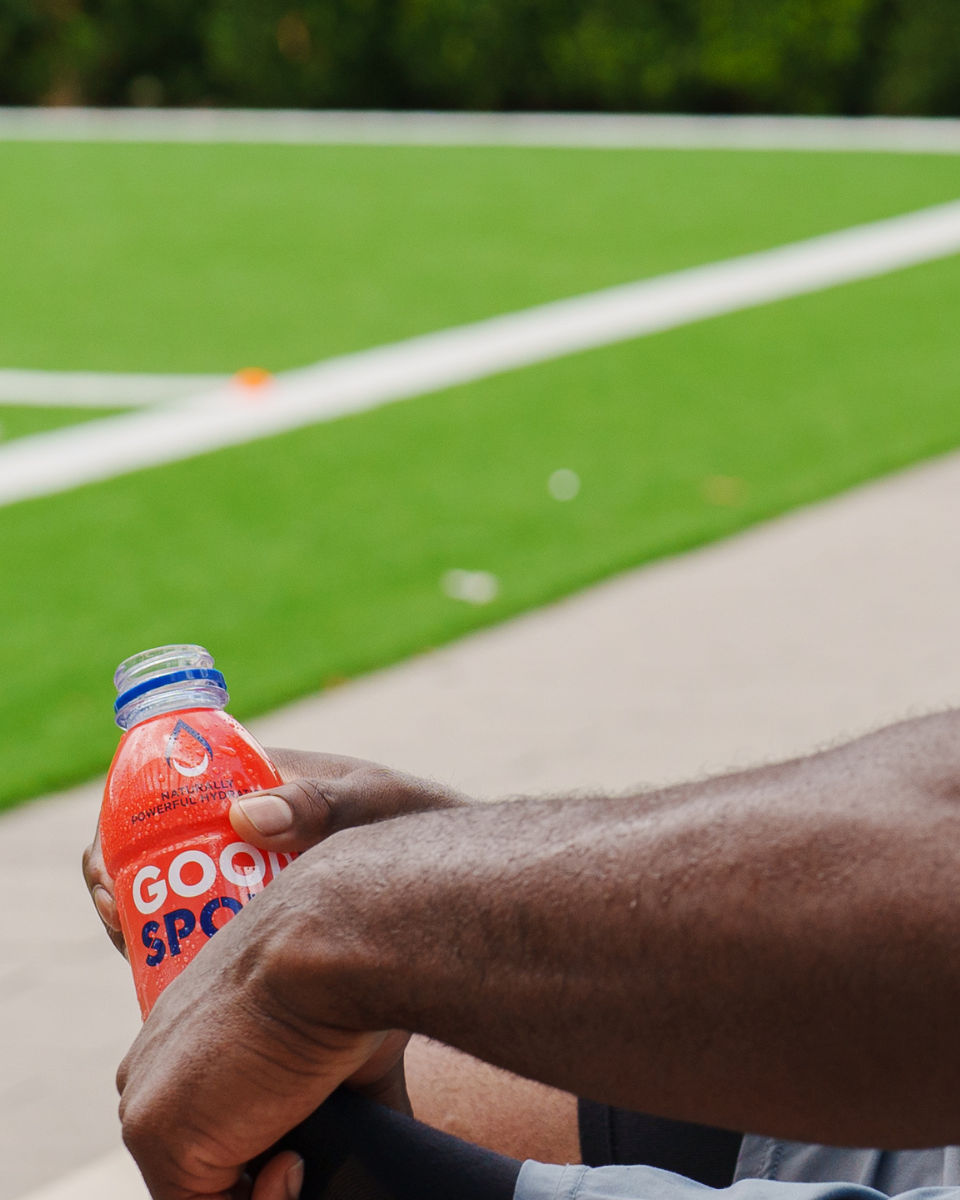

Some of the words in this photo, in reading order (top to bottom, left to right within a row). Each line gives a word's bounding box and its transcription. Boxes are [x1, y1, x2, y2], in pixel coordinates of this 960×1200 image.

[161, 779, 233, 801] NATURALLY
[131, 797, 197, 825] POWERFUL
[141, 893, 255, 967] SPO
